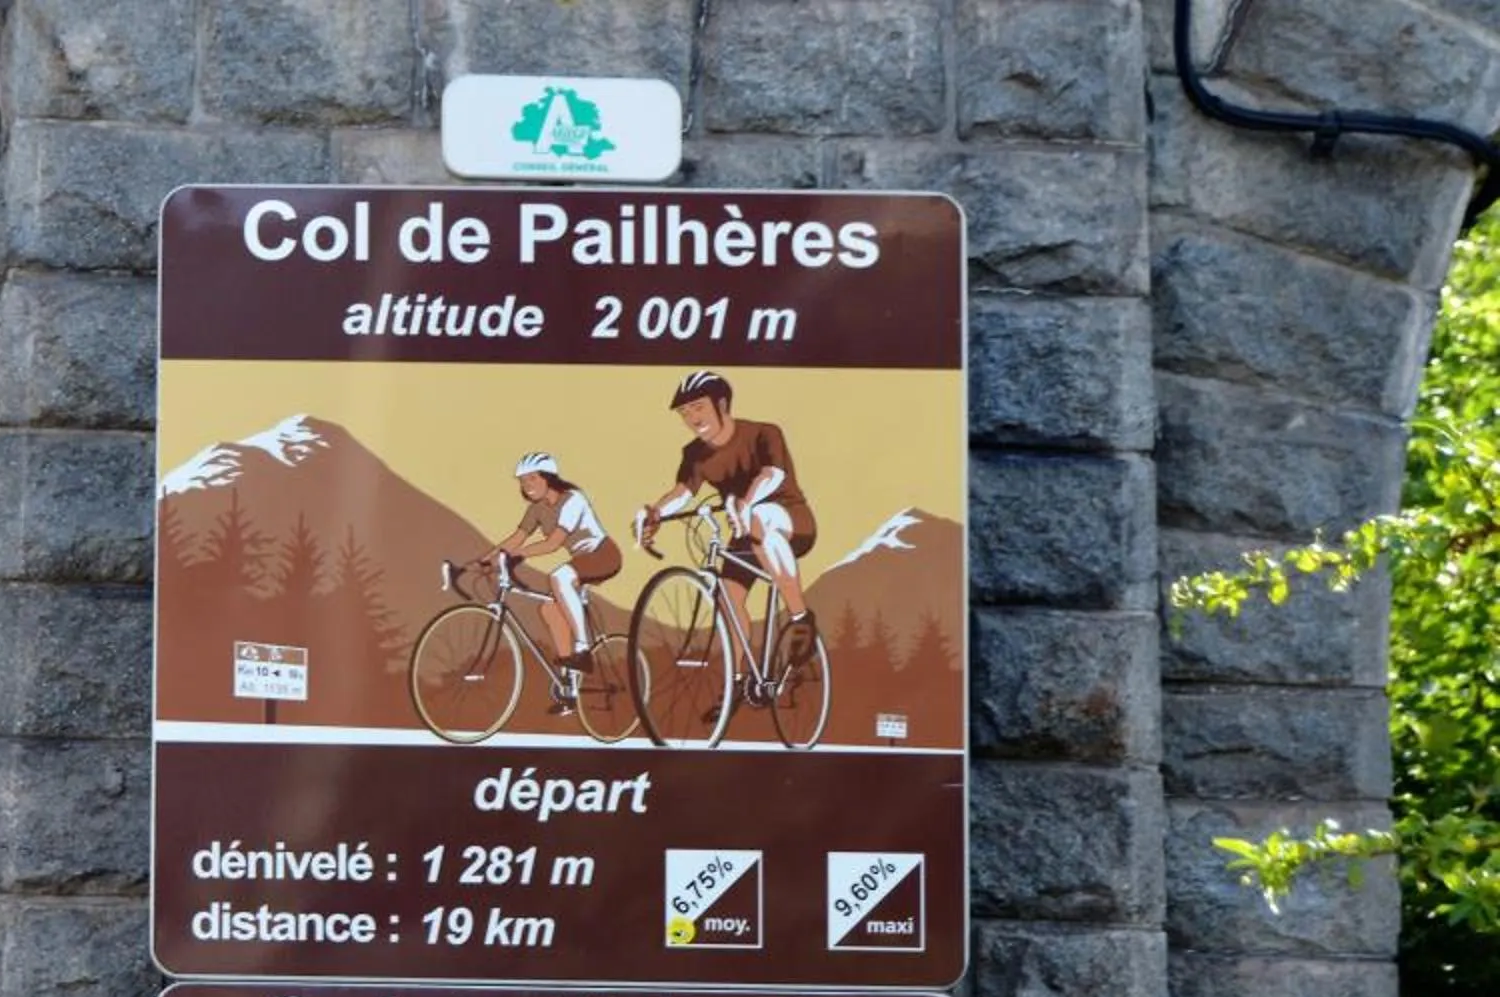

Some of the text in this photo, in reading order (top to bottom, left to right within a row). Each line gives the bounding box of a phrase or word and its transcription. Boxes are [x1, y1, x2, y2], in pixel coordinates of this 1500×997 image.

[243, 198, 881, 269] Col de Pailhères
[342, 292, 545, 338] altitude
[747, 308, 797, 341] m
[474, 767, 652, 822] départ
[192, 839, 374, 881] dénivelé
[550, 856, 595, 885] m
[672, 856, 733, 914] 6,75%
[834, 857, 896, 917] 9,60%
[191, 901, 377, 943] distance
[422, 906, 474, 945] 19
[483, 907, 555, 947] km
[704, 918, 751, 936] moy.
[866, 917, 914, 934] maxi
